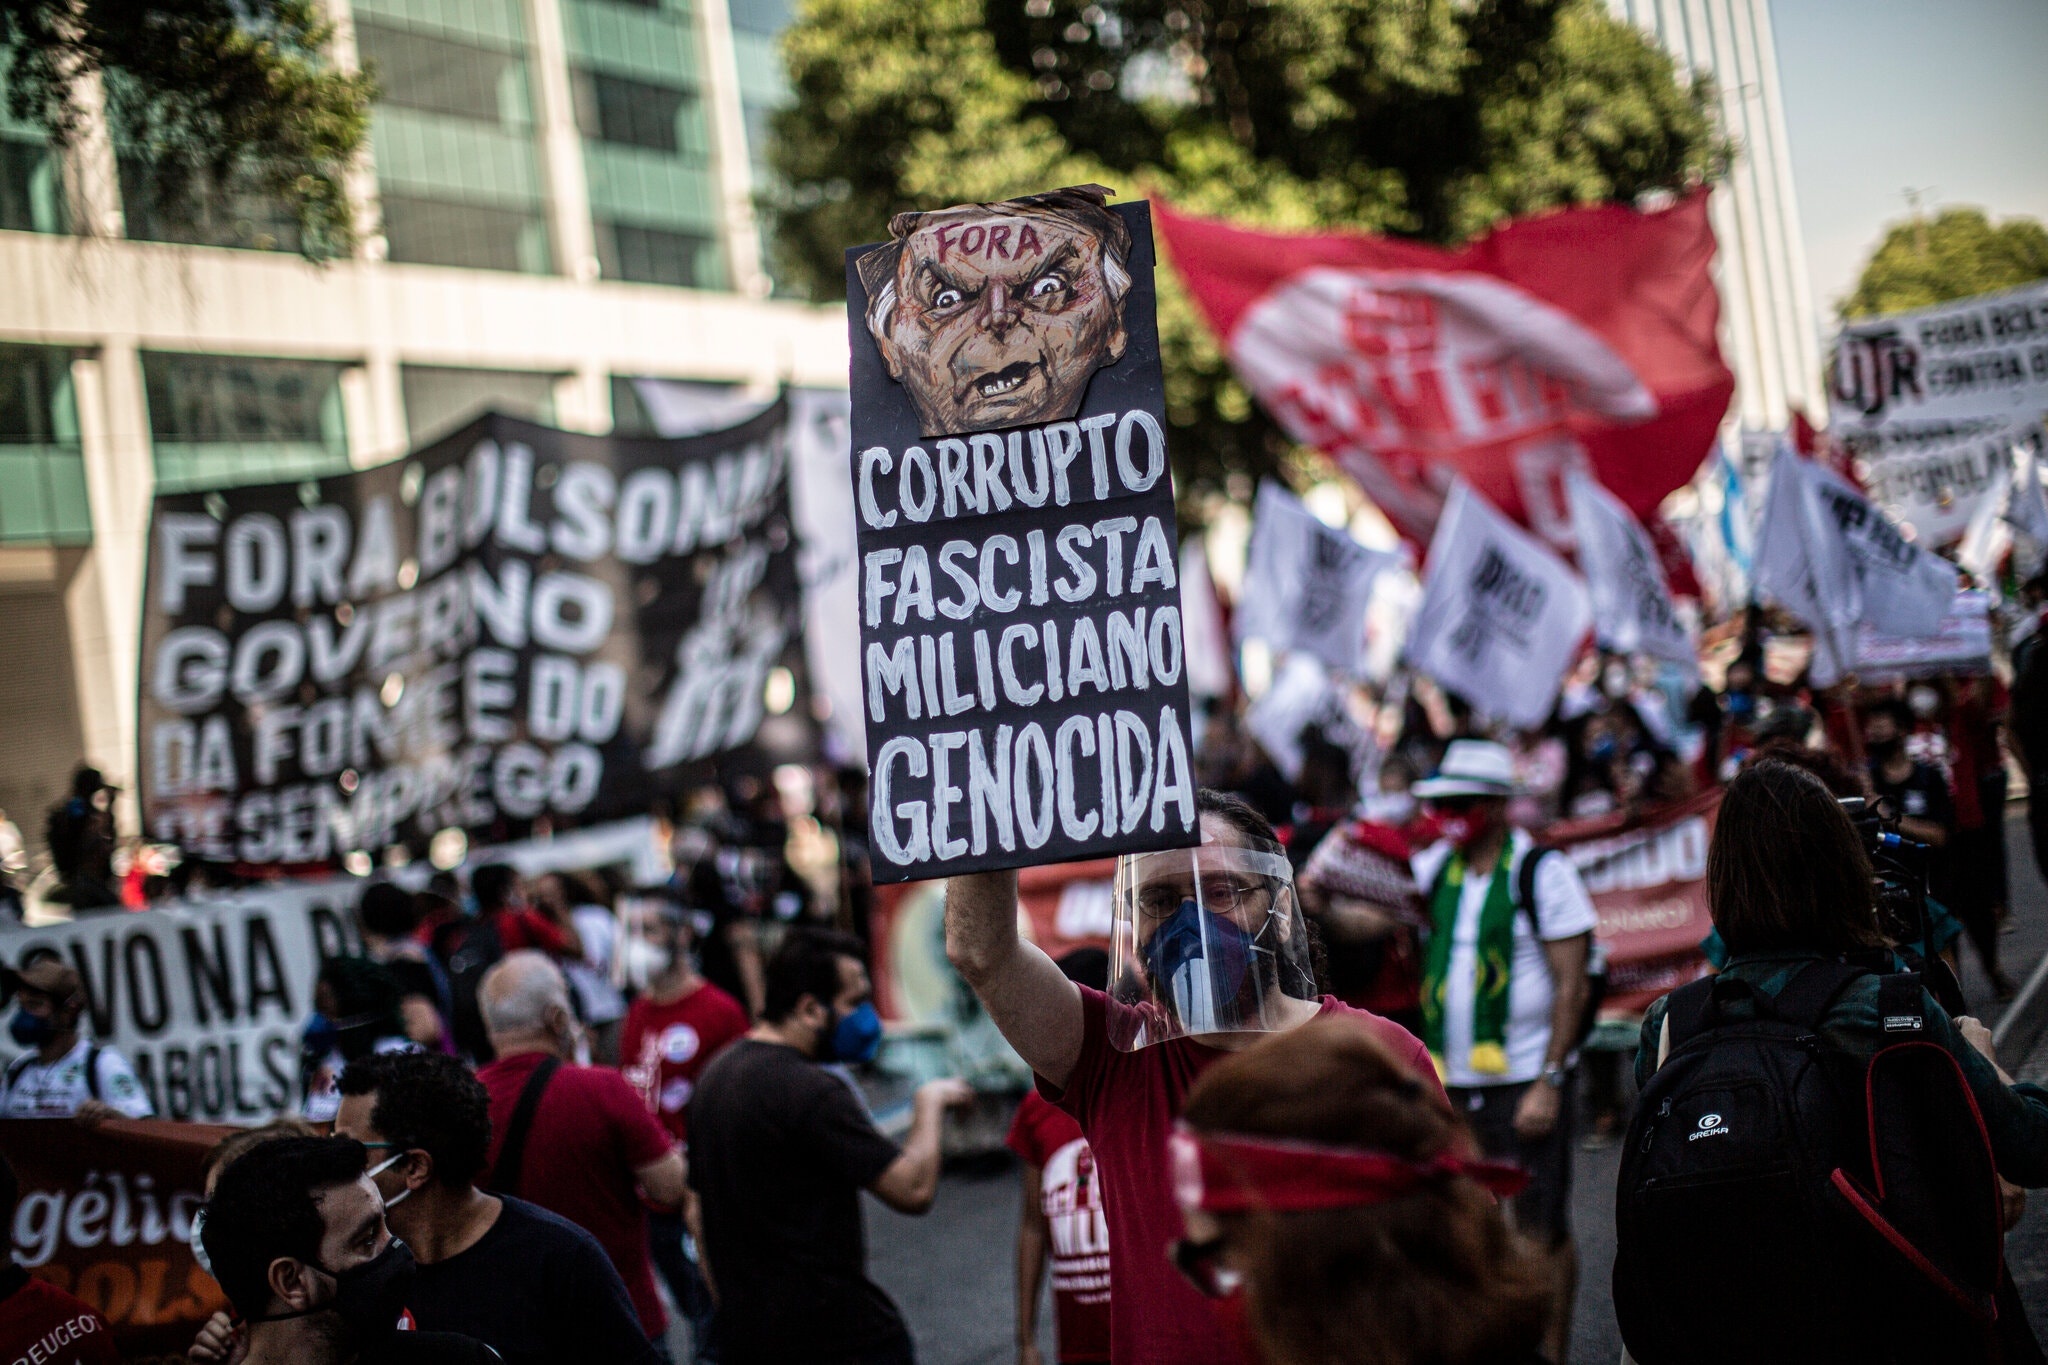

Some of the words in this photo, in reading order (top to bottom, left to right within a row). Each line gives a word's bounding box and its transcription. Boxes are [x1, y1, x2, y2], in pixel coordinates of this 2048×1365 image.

[934, 219, 1043, 265] FORA
[858, 409, 1166, 530] CORRUPTO
[158, 501, 399, 613] FORA
[865, 516, 1176, 627] FASCISTA
[152, 560, 614, 714] GOVERNO
[867, 605, 1182, 722] MILICIANO
[152, 716, 237, 798] DA
[466, 648, 517, 742] E
[526, 655, 628, 744] DO
[871, 705, 1195, 866] GENOCIDA
[179, 908, 293, 1028] NA
[1688, 1126, 1729, 1142] GREIKA
